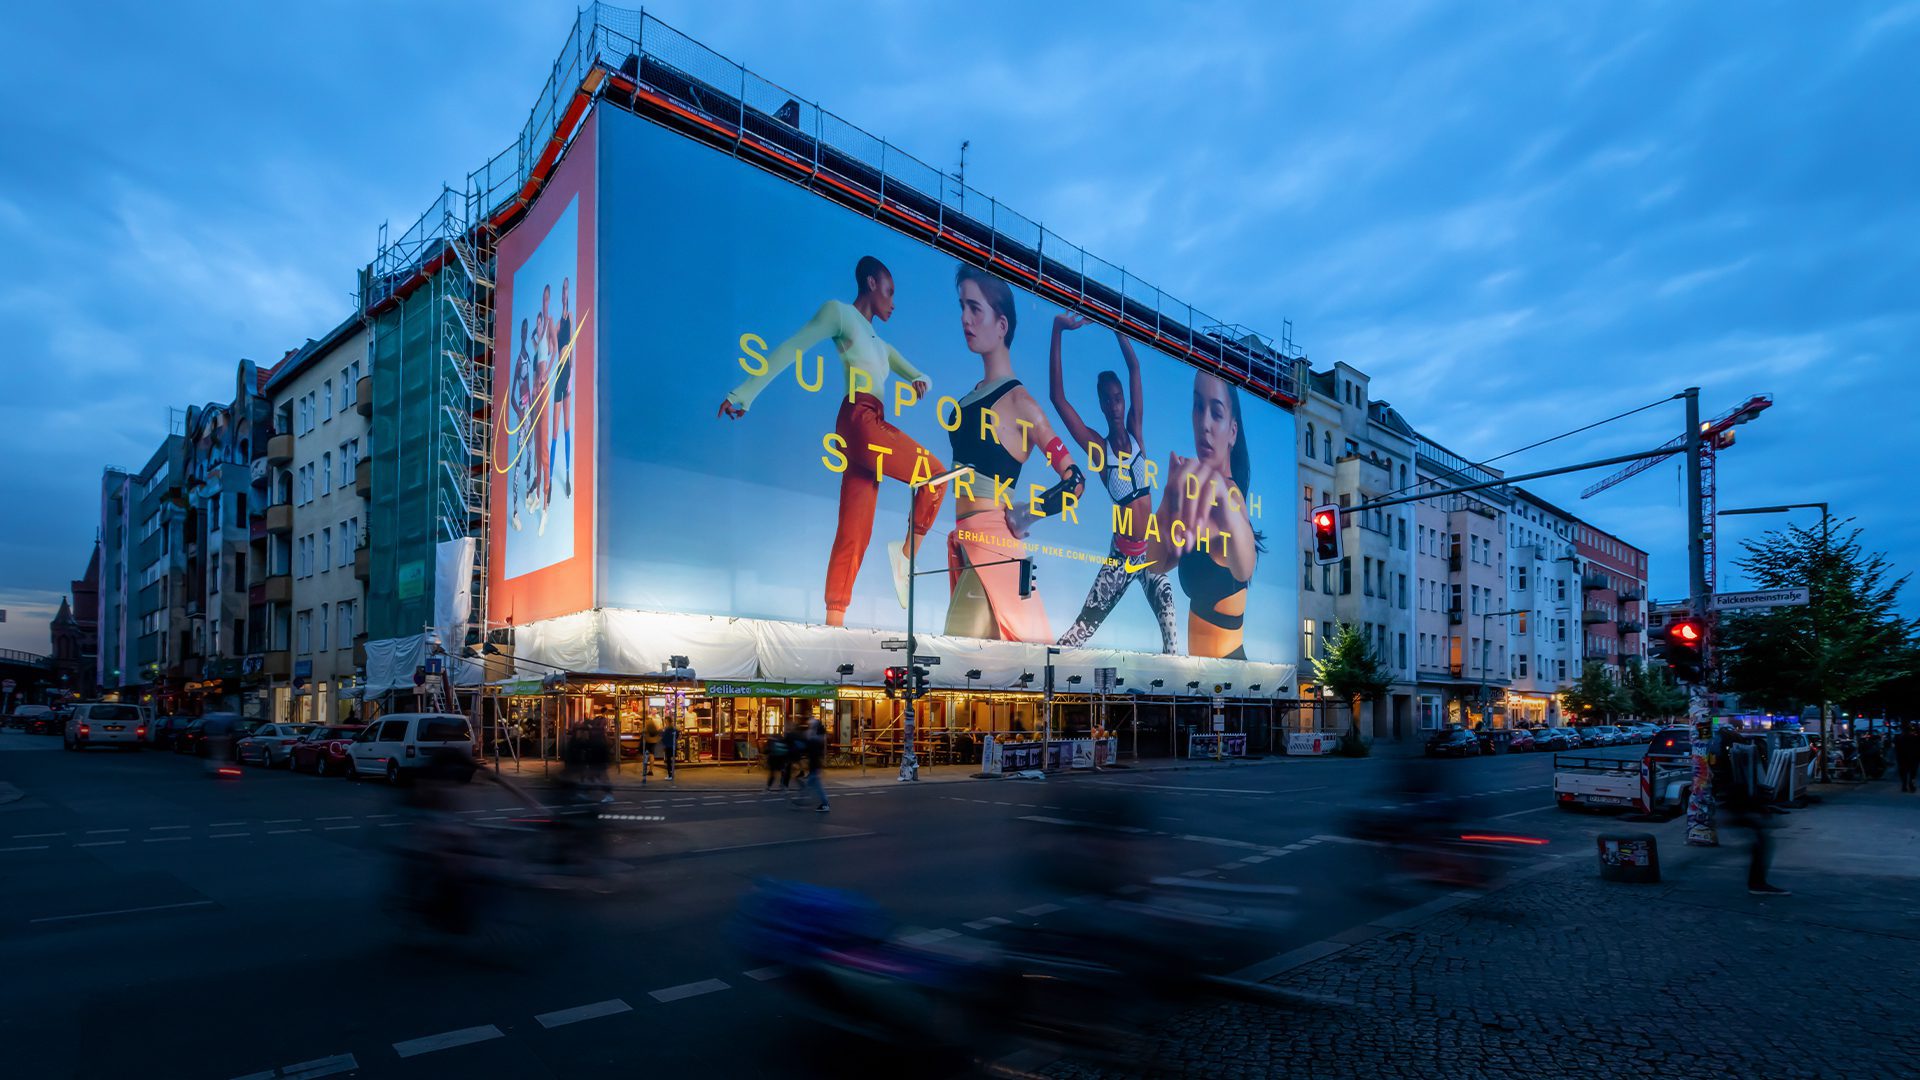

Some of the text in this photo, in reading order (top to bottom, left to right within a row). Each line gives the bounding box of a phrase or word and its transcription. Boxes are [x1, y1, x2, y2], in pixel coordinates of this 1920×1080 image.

[738, 332, 1262, 519] SUPPORT, DER DICH
[821, 433, 1231, 558] STÄRKER MACHT
[958, 529, 1019, 549] ERHÄLTLICH
[1022, 542, 1039, 553] AUF
[1716, 591, 1802, 605] Falckensteinstraße
